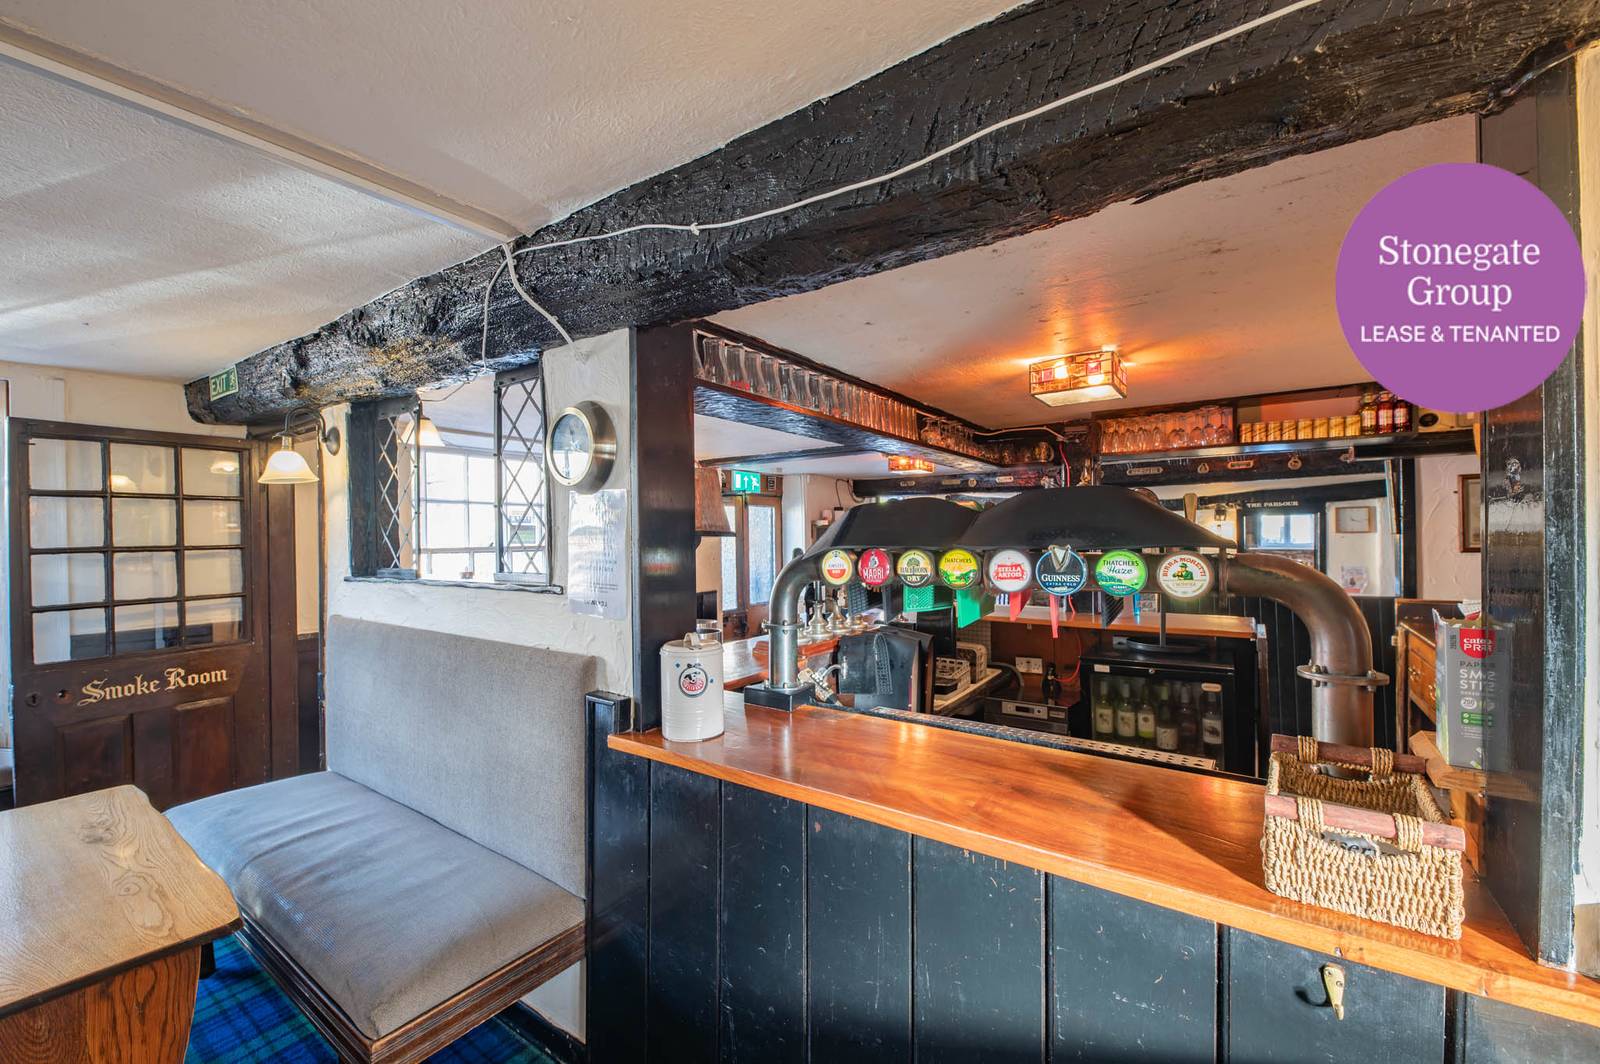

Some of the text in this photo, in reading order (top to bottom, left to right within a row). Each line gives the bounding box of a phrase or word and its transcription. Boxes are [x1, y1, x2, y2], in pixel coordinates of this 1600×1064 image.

[211, 373, 228, 397] EXIT
[1103, 559, 1139, 567] THATCHERS
[1162, 557, 1207, 577] BIRRA MORETTI
[1041, 573, 1081, 582] GUINNESS
[1107, 566, 1133, 576] Haze
[77, 666, 230, 707] Smoke Room
